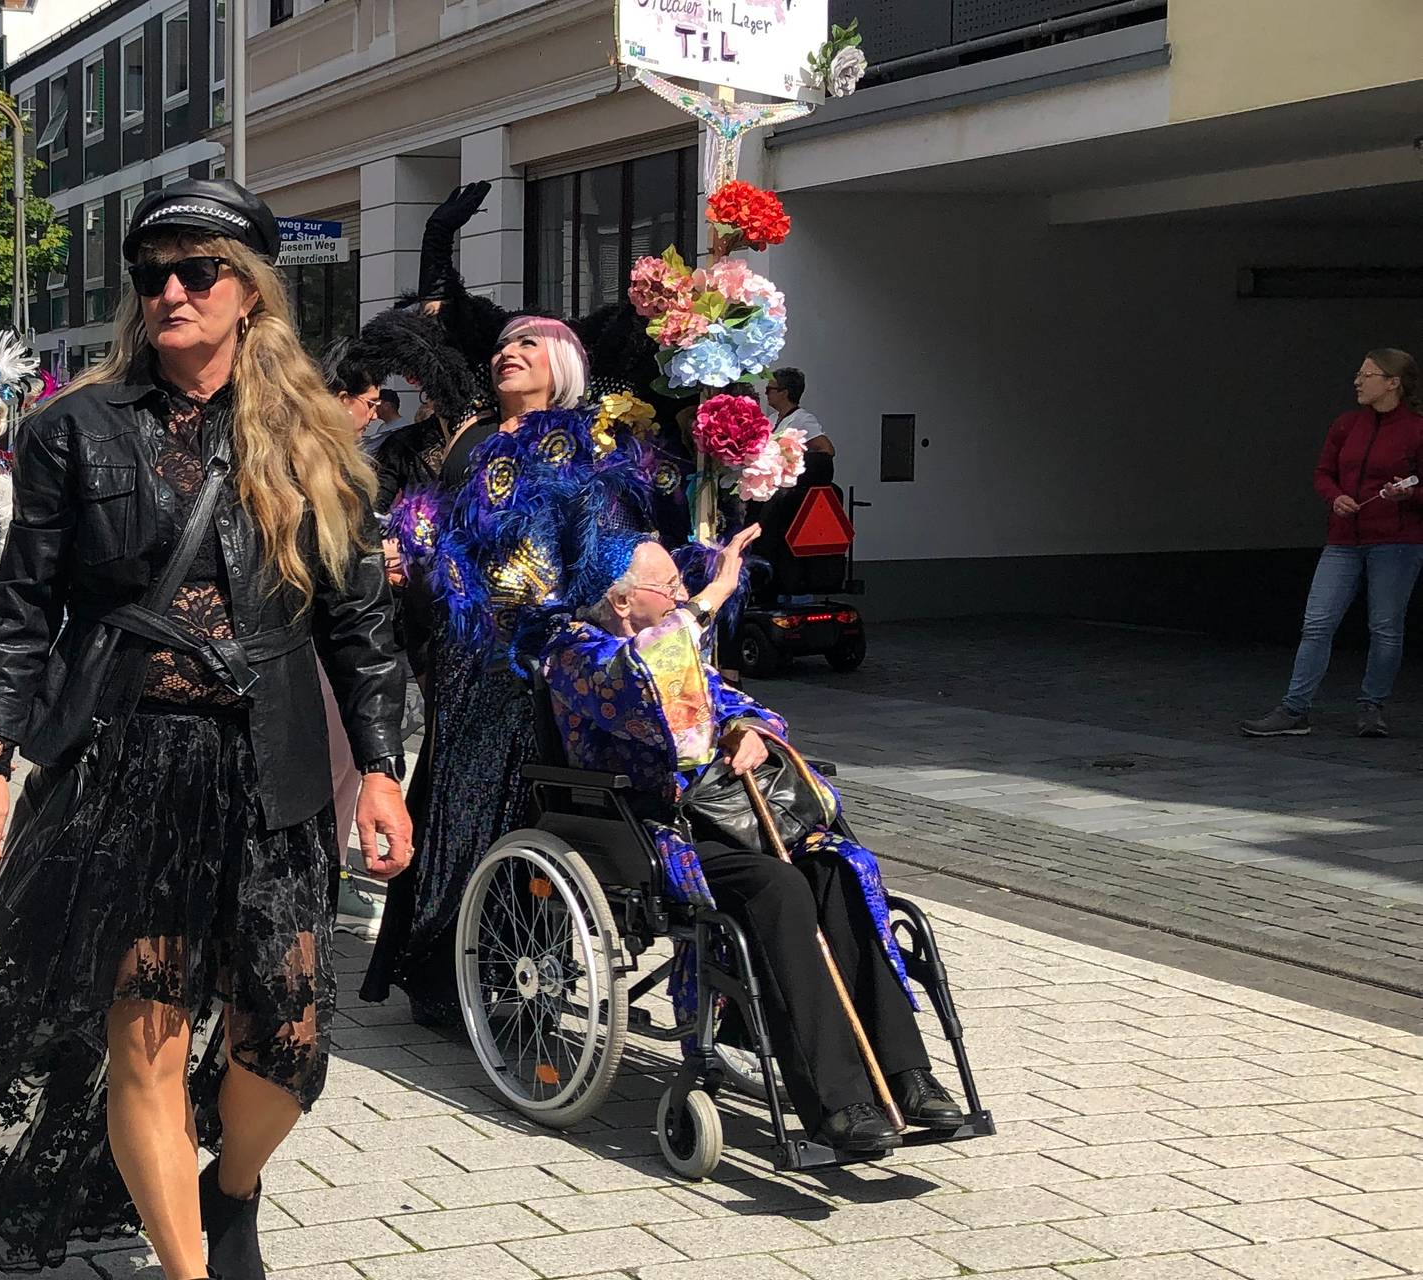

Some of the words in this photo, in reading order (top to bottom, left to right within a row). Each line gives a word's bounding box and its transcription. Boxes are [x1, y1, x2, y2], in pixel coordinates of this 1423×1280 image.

[637, 0, 701, 16] eater
[708, 2, 722, 23] im
[731, 3, 772, 35] Lager
[304, 222, 322, 231] zur
[314, 241, 335, 251] Weg
[278, 254, 338, 264] Winterdienst
